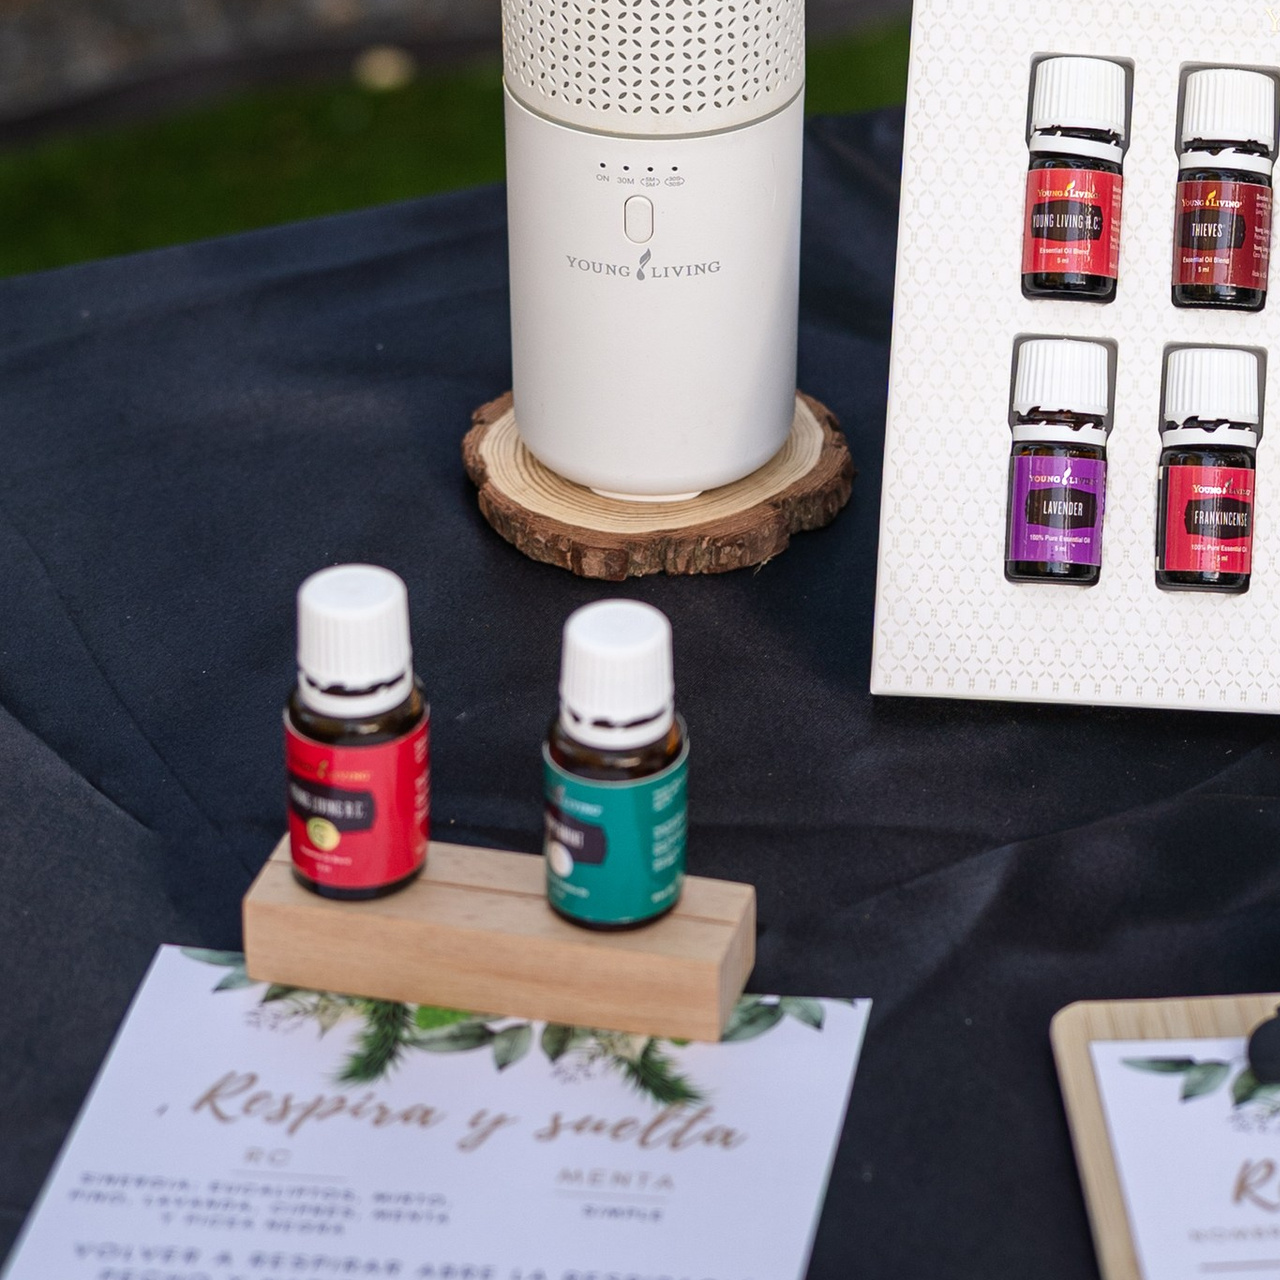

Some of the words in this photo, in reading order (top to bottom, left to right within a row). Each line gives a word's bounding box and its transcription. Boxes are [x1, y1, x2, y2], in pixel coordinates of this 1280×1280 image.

[1033, 214, 1054, 229] YOUNG
[1057, 214, 1083, 228] LIVING
[1192, 223, 1223, 237] THIEVES
[566, 255, 631, 278] YOUNG
[652, 261, 721, 279] LIVING
[1043, 500, 1083, 516] LAVENDER
[1195, 510, 1247, 527] FRANKINCENSE
[192, 1070, 445, 1136] Respira
[458, 1108, 519, 1152] y
[534, 1101, 748, 1152] suelta
[558, 1168, 676, 1190] MENTA
[73, 1241, 201, 1263] VOLVER
[248, 1249, 404, 1274] RESPIRAR
